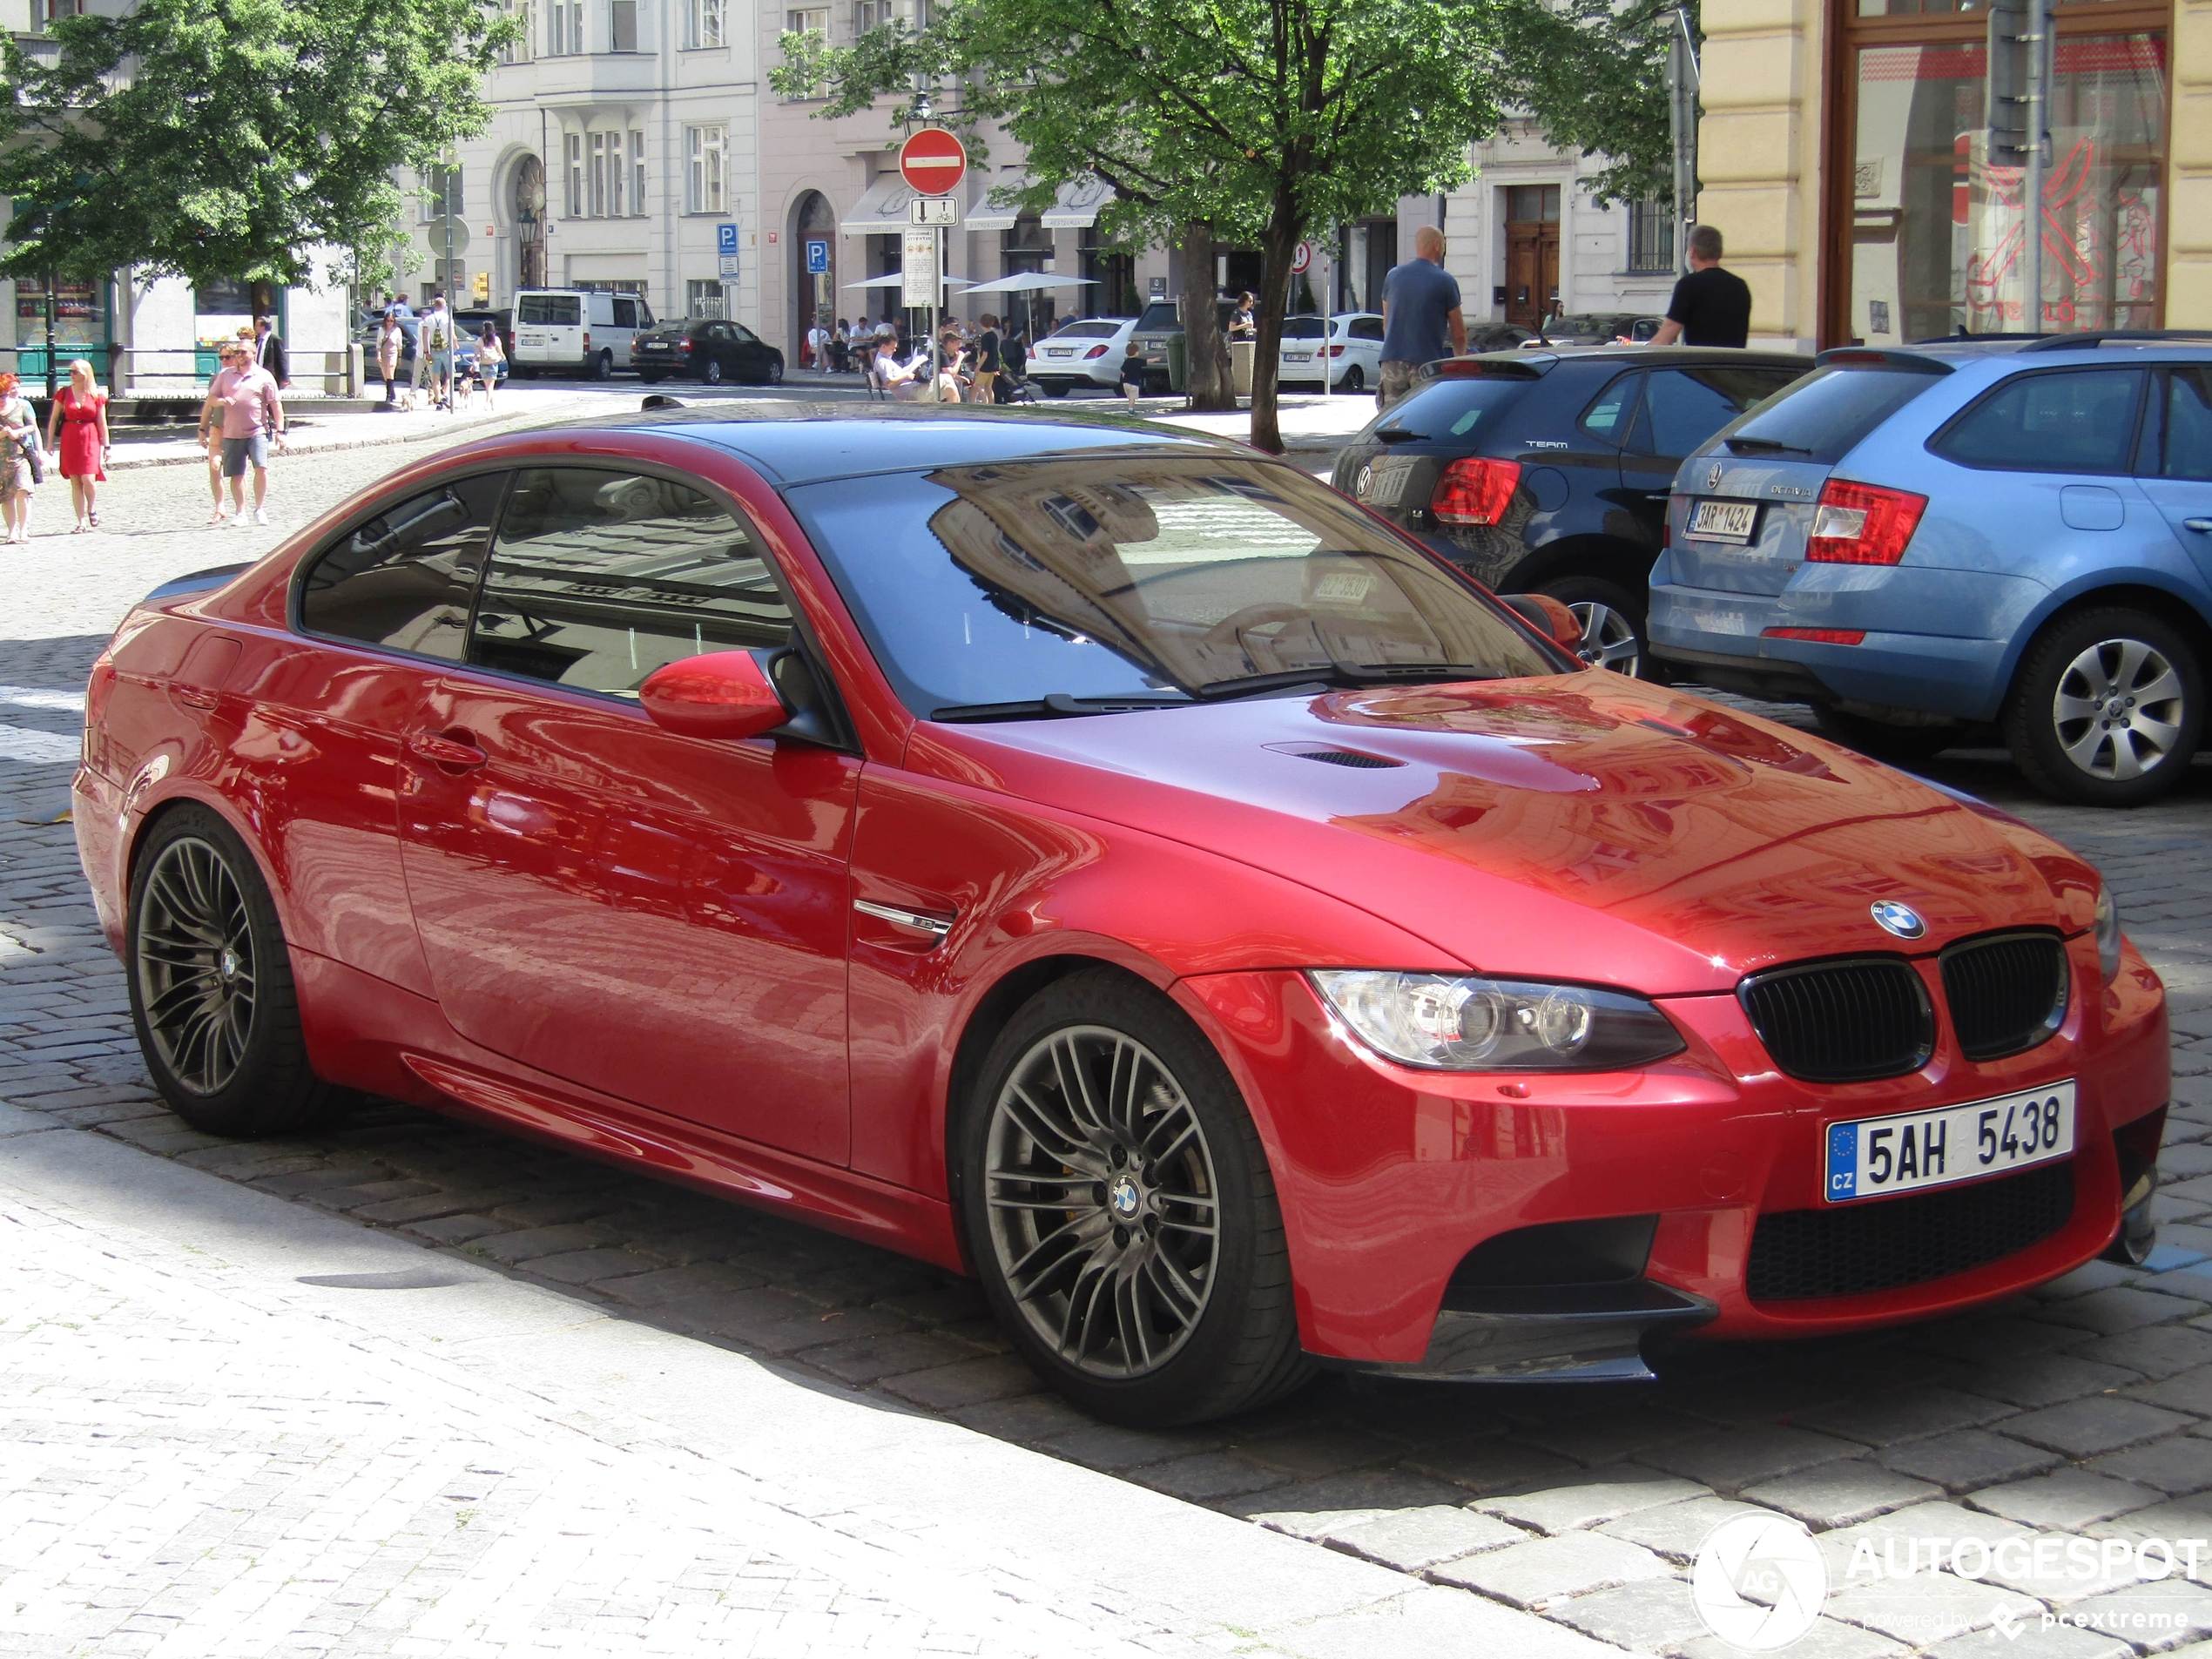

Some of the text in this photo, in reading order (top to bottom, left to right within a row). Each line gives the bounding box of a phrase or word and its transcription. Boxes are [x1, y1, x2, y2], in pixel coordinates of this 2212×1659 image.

[721, 227, 733, 246] P
[811, 245, 823, 264] P
[1771, 485, 1811, 497] OCTAVIA
[1697, 504, 1750, 532] 3AR 1424
[1868, 1095, 2060, 1184] 5AH 5438
[1832, 1172, 1853, 1190] CZ
